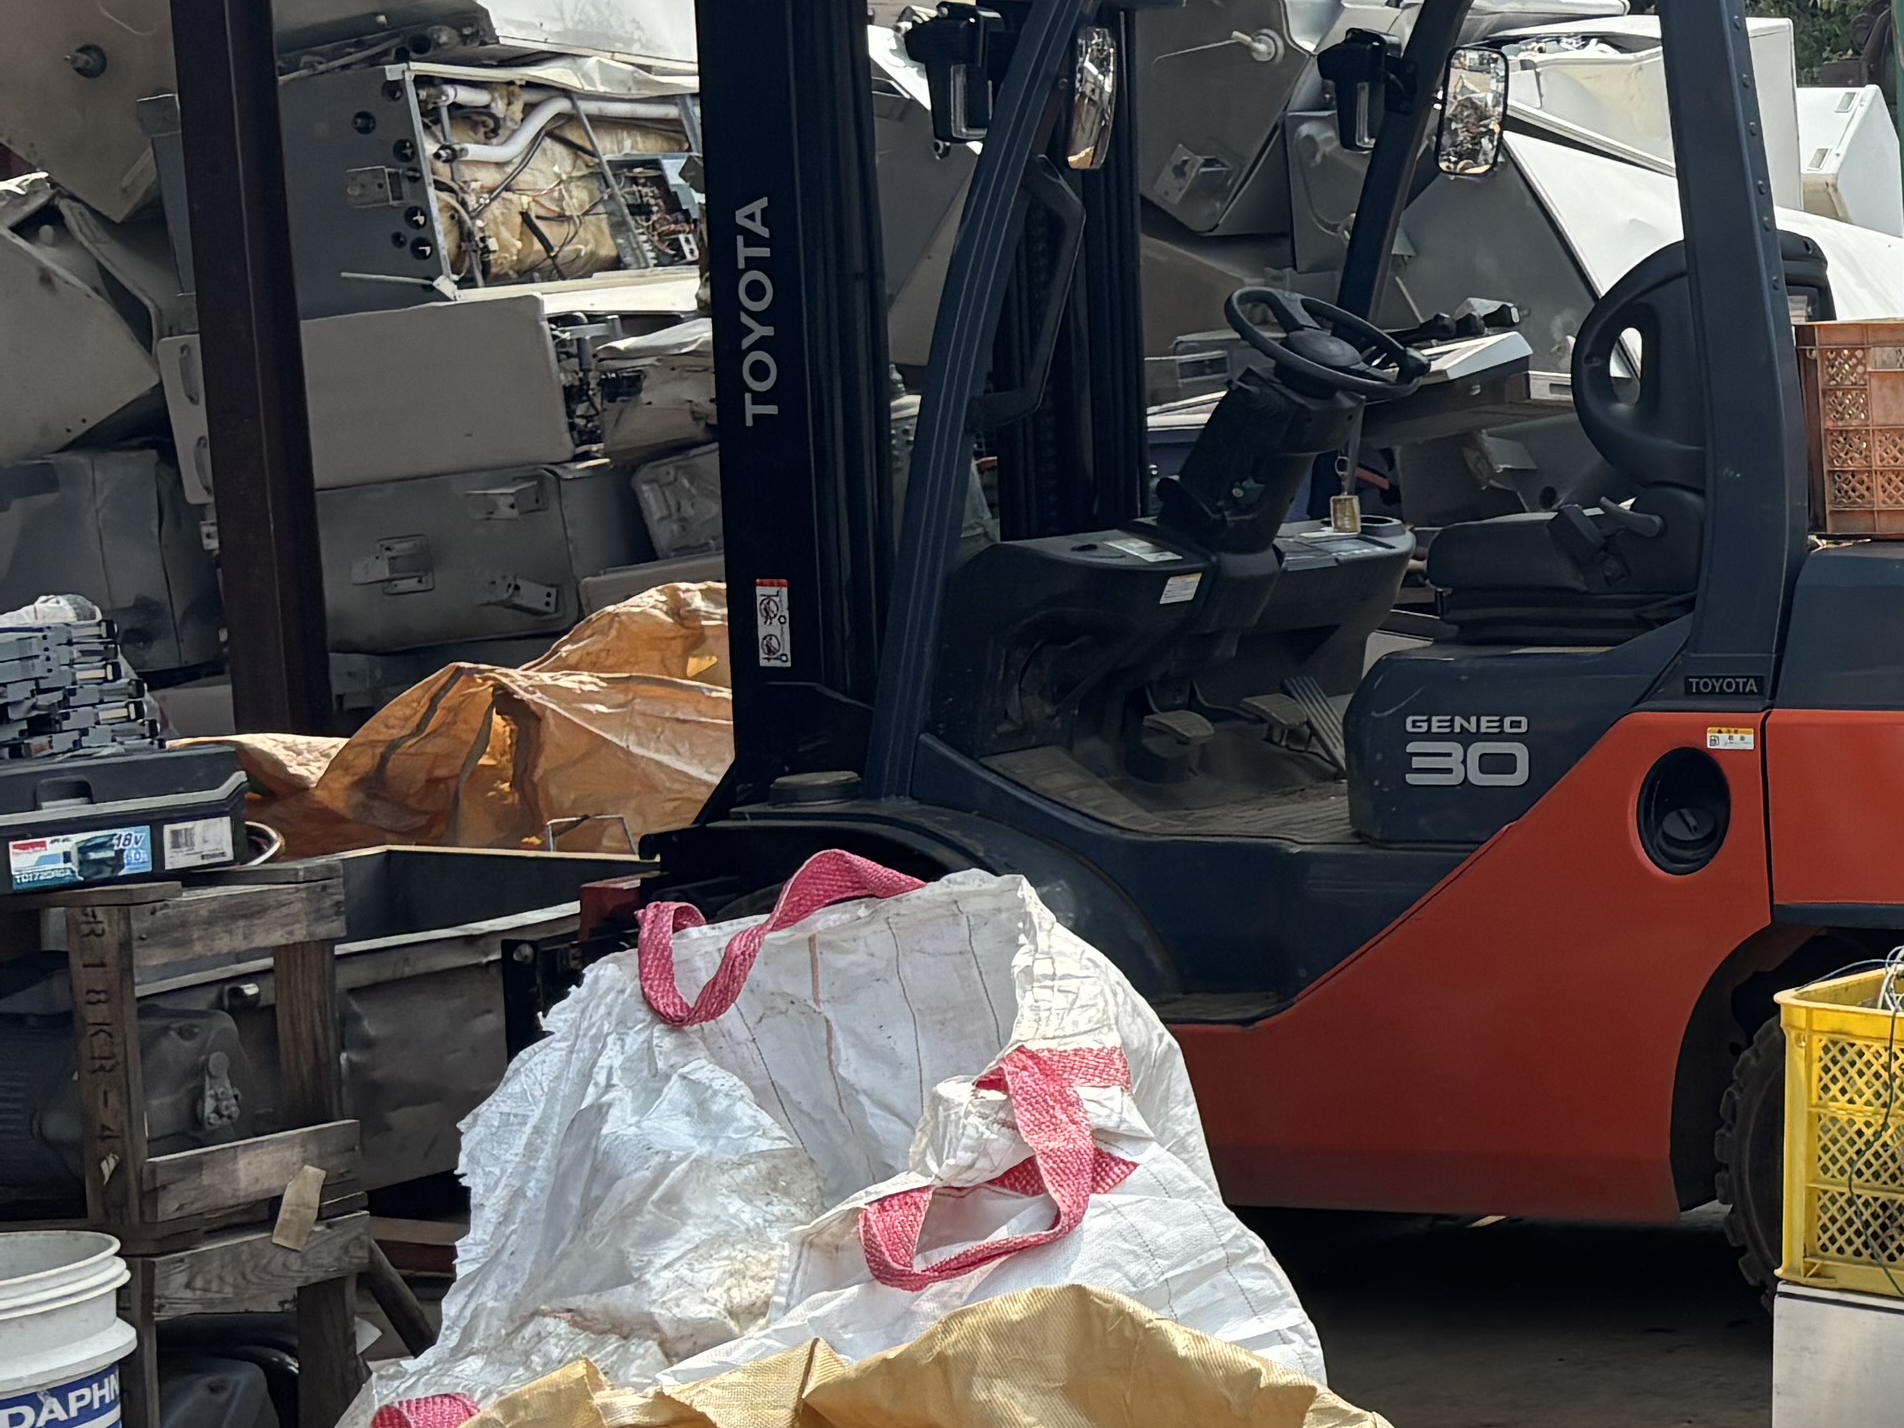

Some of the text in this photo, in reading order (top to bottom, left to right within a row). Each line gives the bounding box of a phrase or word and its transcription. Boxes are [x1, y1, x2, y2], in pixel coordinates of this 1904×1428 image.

[735, 196, 779, 427] TOYOTA
[1688, 677, 1759, 693] TOYOTA
[1405, 715, 1529, 734] GENEO
[1405, 741, 1530, 786] 30
